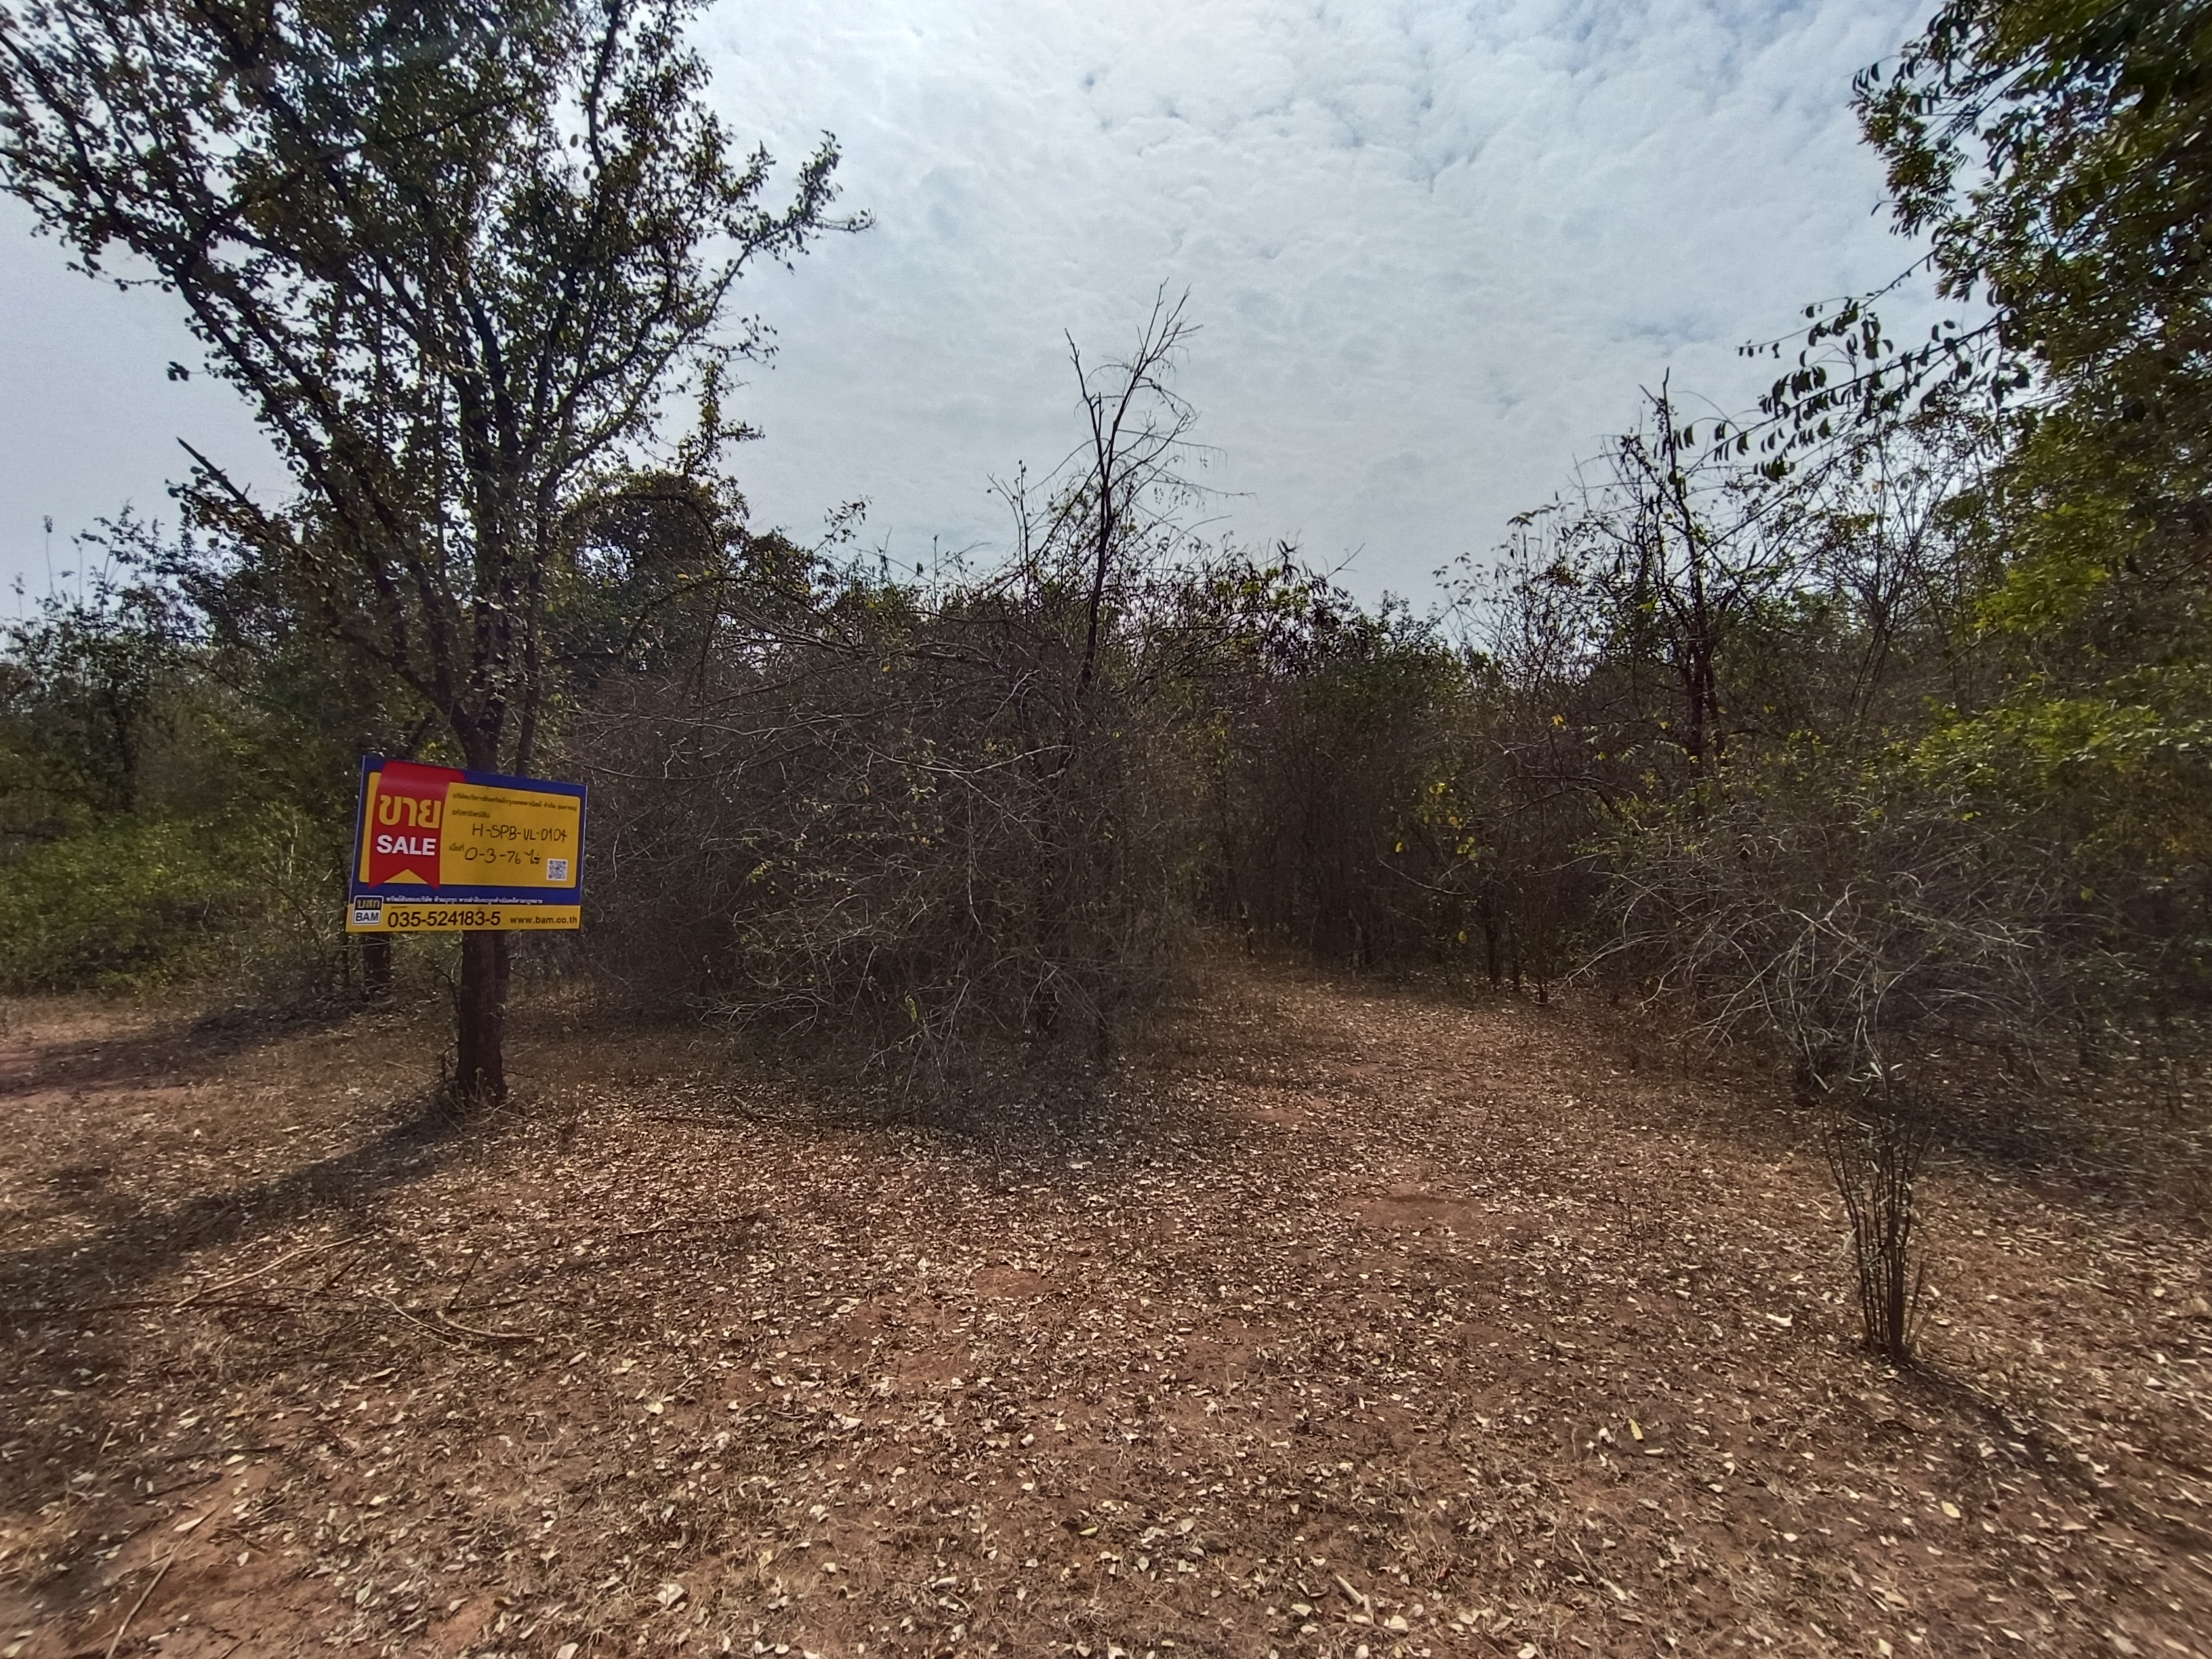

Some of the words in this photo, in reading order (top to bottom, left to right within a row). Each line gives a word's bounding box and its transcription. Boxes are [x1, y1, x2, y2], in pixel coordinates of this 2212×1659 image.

[378, 794, 442, 829] ขาย
[377, 834, 436, 856] SALE
[355, 912, 380, 922] BAM
[388, 911, 501, 928] 035-524183-5
[510, 916, 577, 924] www.bam.co.th
